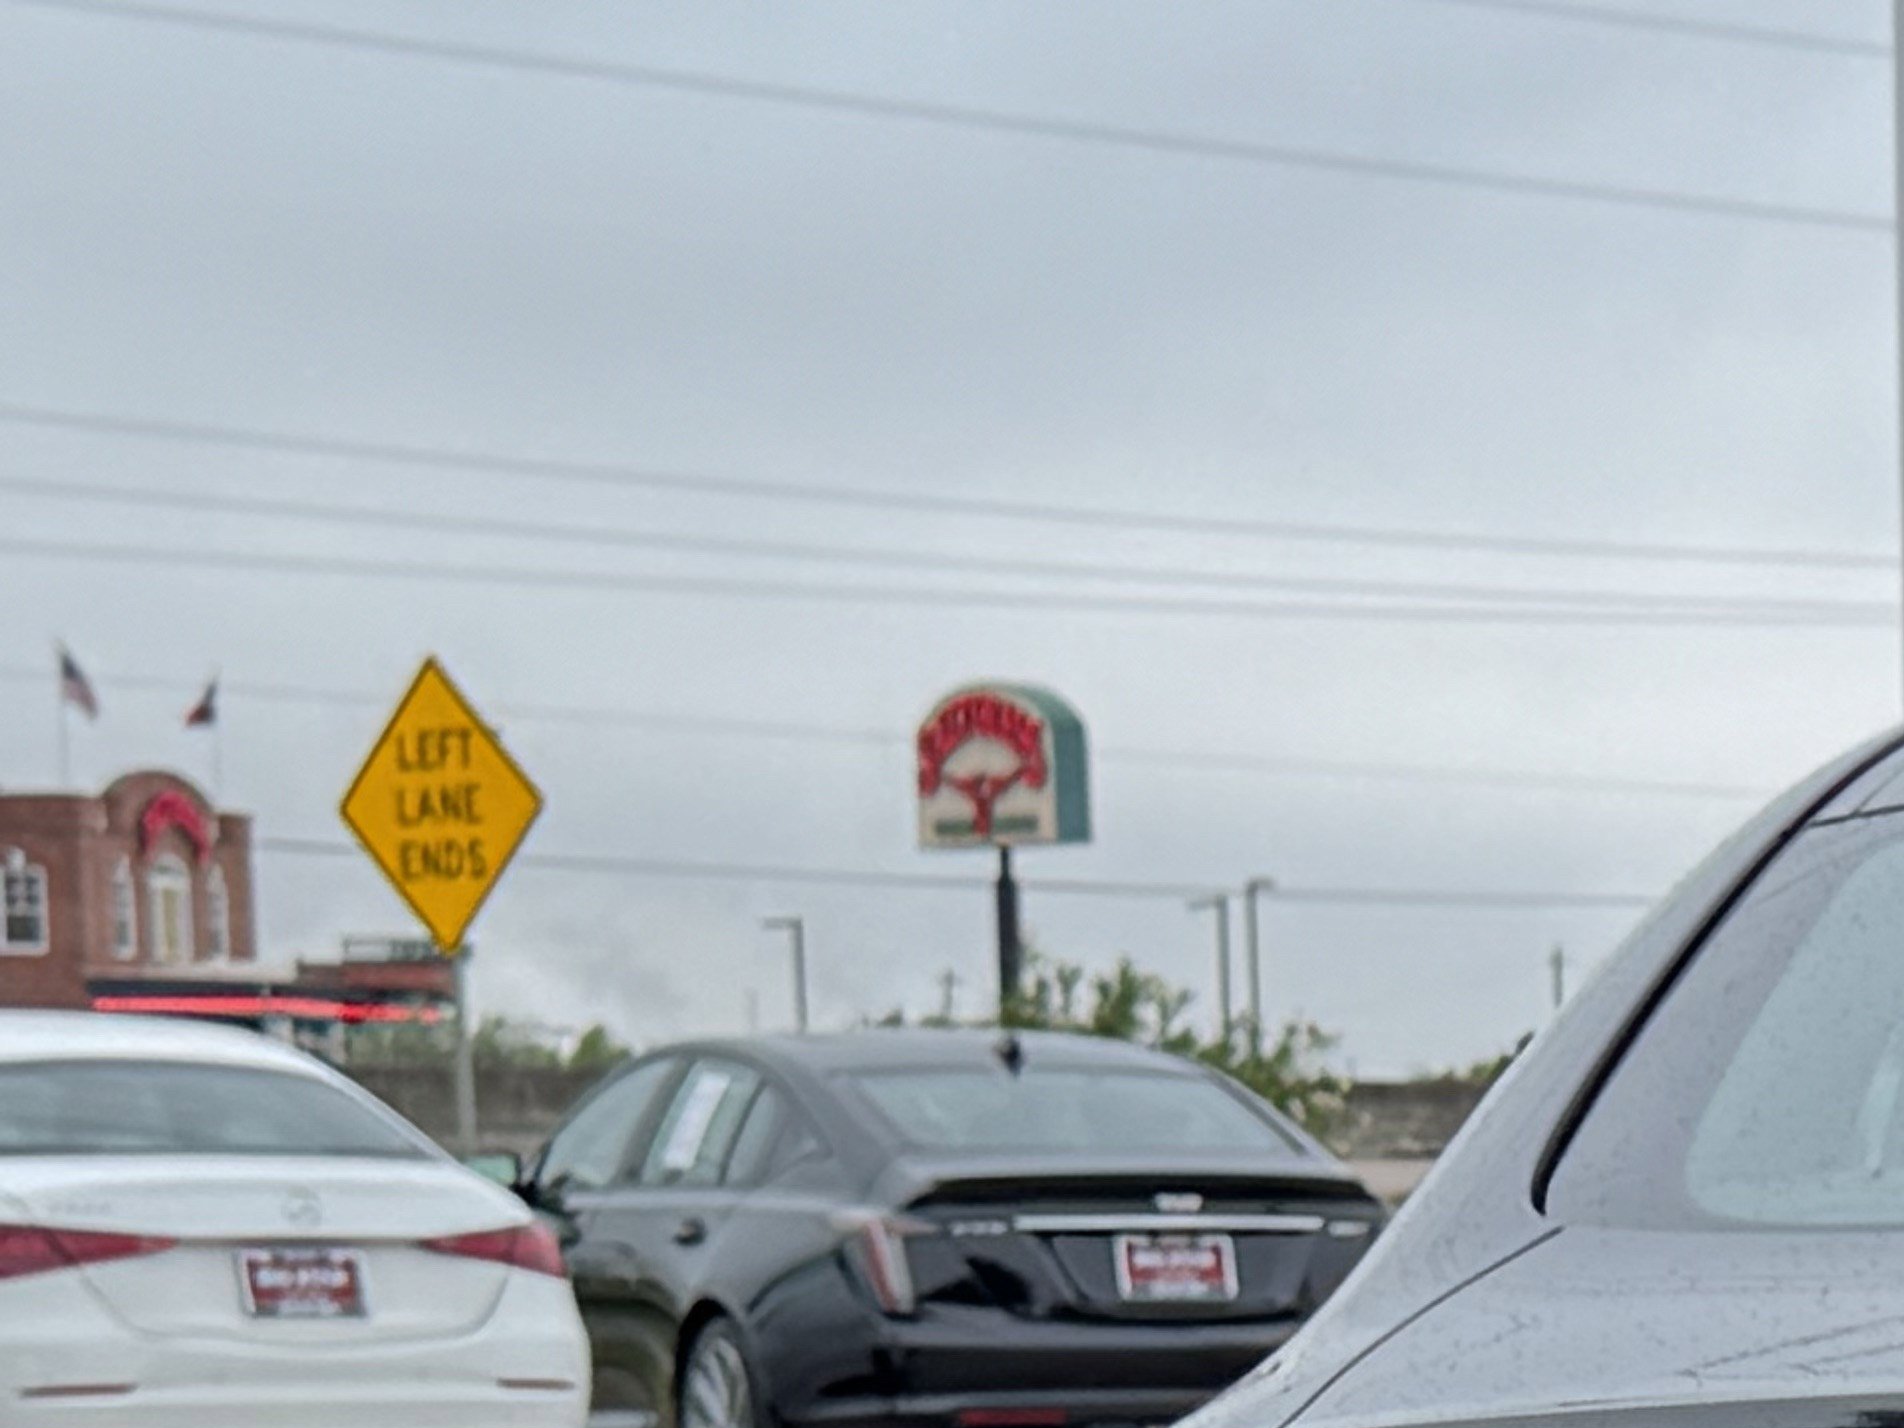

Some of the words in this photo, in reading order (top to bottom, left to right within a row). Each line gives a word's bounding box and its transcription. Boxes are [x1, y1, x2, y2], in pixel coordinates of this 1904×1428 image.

[396, 727, 470, 771] LEFT
[396, 782, 482, 826] LANE
[400, 836, 487, 880] ENDS
